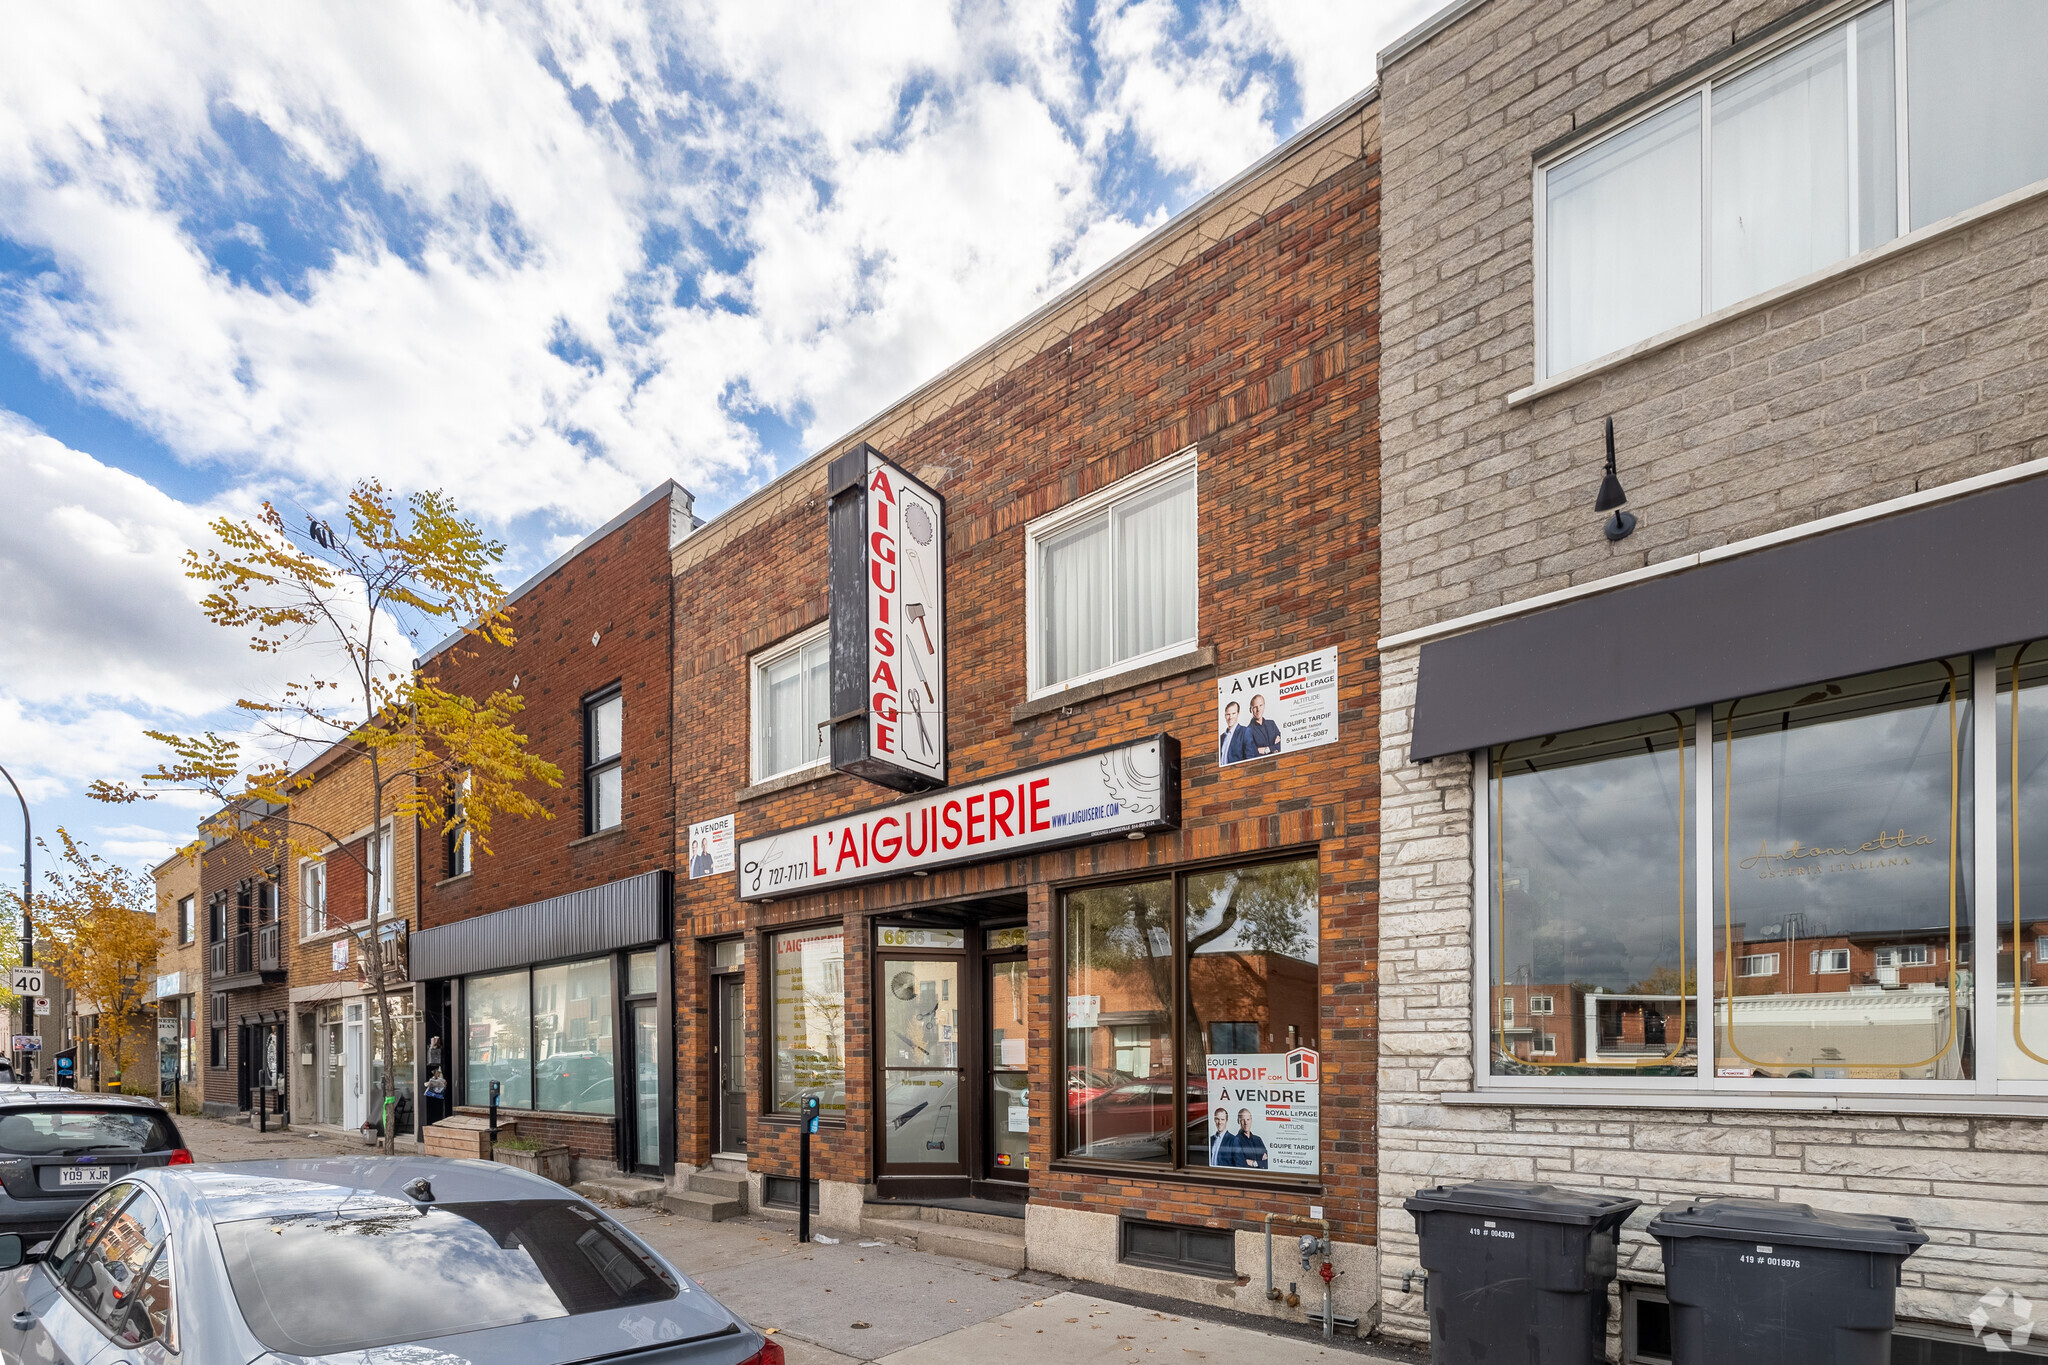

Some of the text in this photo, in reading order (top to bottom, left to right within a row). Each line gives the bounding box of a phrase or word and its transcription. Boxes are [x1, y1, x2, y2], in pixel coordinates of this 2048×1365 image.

[869, 469, 899, 755] AIGUISAGE
[1231, 657, 1322, 695] À VENDRE
[1279, 681, 1305, 696] ROYAL
[1292, 693, 1321, 706] ALTITUDE
[1308, 711, 1332, 723] TARDIF
[1285, 728, 1329, 744] 514-447-8087
[1051, 802, 1120, 828] WWW.LAIGUISERIE.COM
[700, 819, 729, 834] VENDRE
[813, 777, 1051, 877] L'AIGUISERIE
[1739, 828, 1937, 870] Antonietta
[768, 861, 809, 886] 727-7171
[1758, 856, 1911, 880] OSTERIA ITALIANA
[884, 929, 926, 946] 6666
[15, 976, 41, 992] 40
[1219, 1086, 1306, 1103] À VENDRE
[1265, 1109, 1290, 1117] ROYAL
[1278, 1123, 1305, 1131] ALTITUDE
[1293, 1143, 1316, 1151] TARDIF
[1272, 1157, 1313, 1166] 514-447-8087
[89, 1170, 109, 1181] XJR
[1469, 1227, 1481, 1236] 419
[1740, 1254, 1755, 1264] 419
[1767, 1257, 1801, 1269] 0019976
